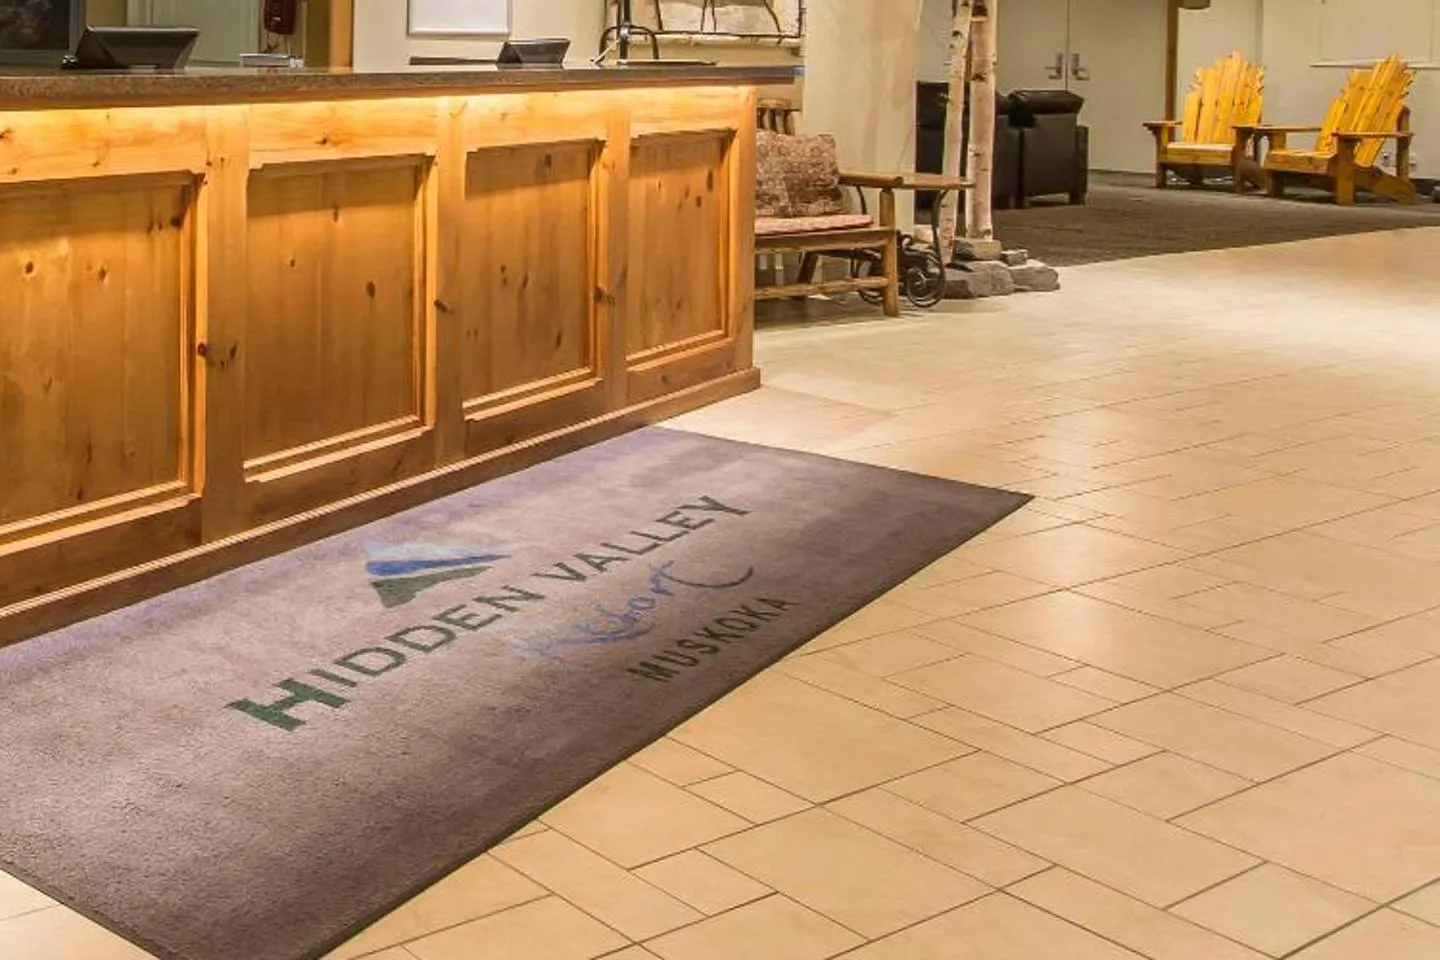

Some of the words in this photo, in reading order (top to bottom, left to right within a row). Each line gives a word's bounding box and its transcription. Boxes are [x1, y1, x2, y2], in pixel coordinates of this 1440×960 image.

[224, 584, 545, 731] HIDDEN
[531, 495, 751, 584] VALLEY
[626, 596, 799, 683] MUSKOKA
